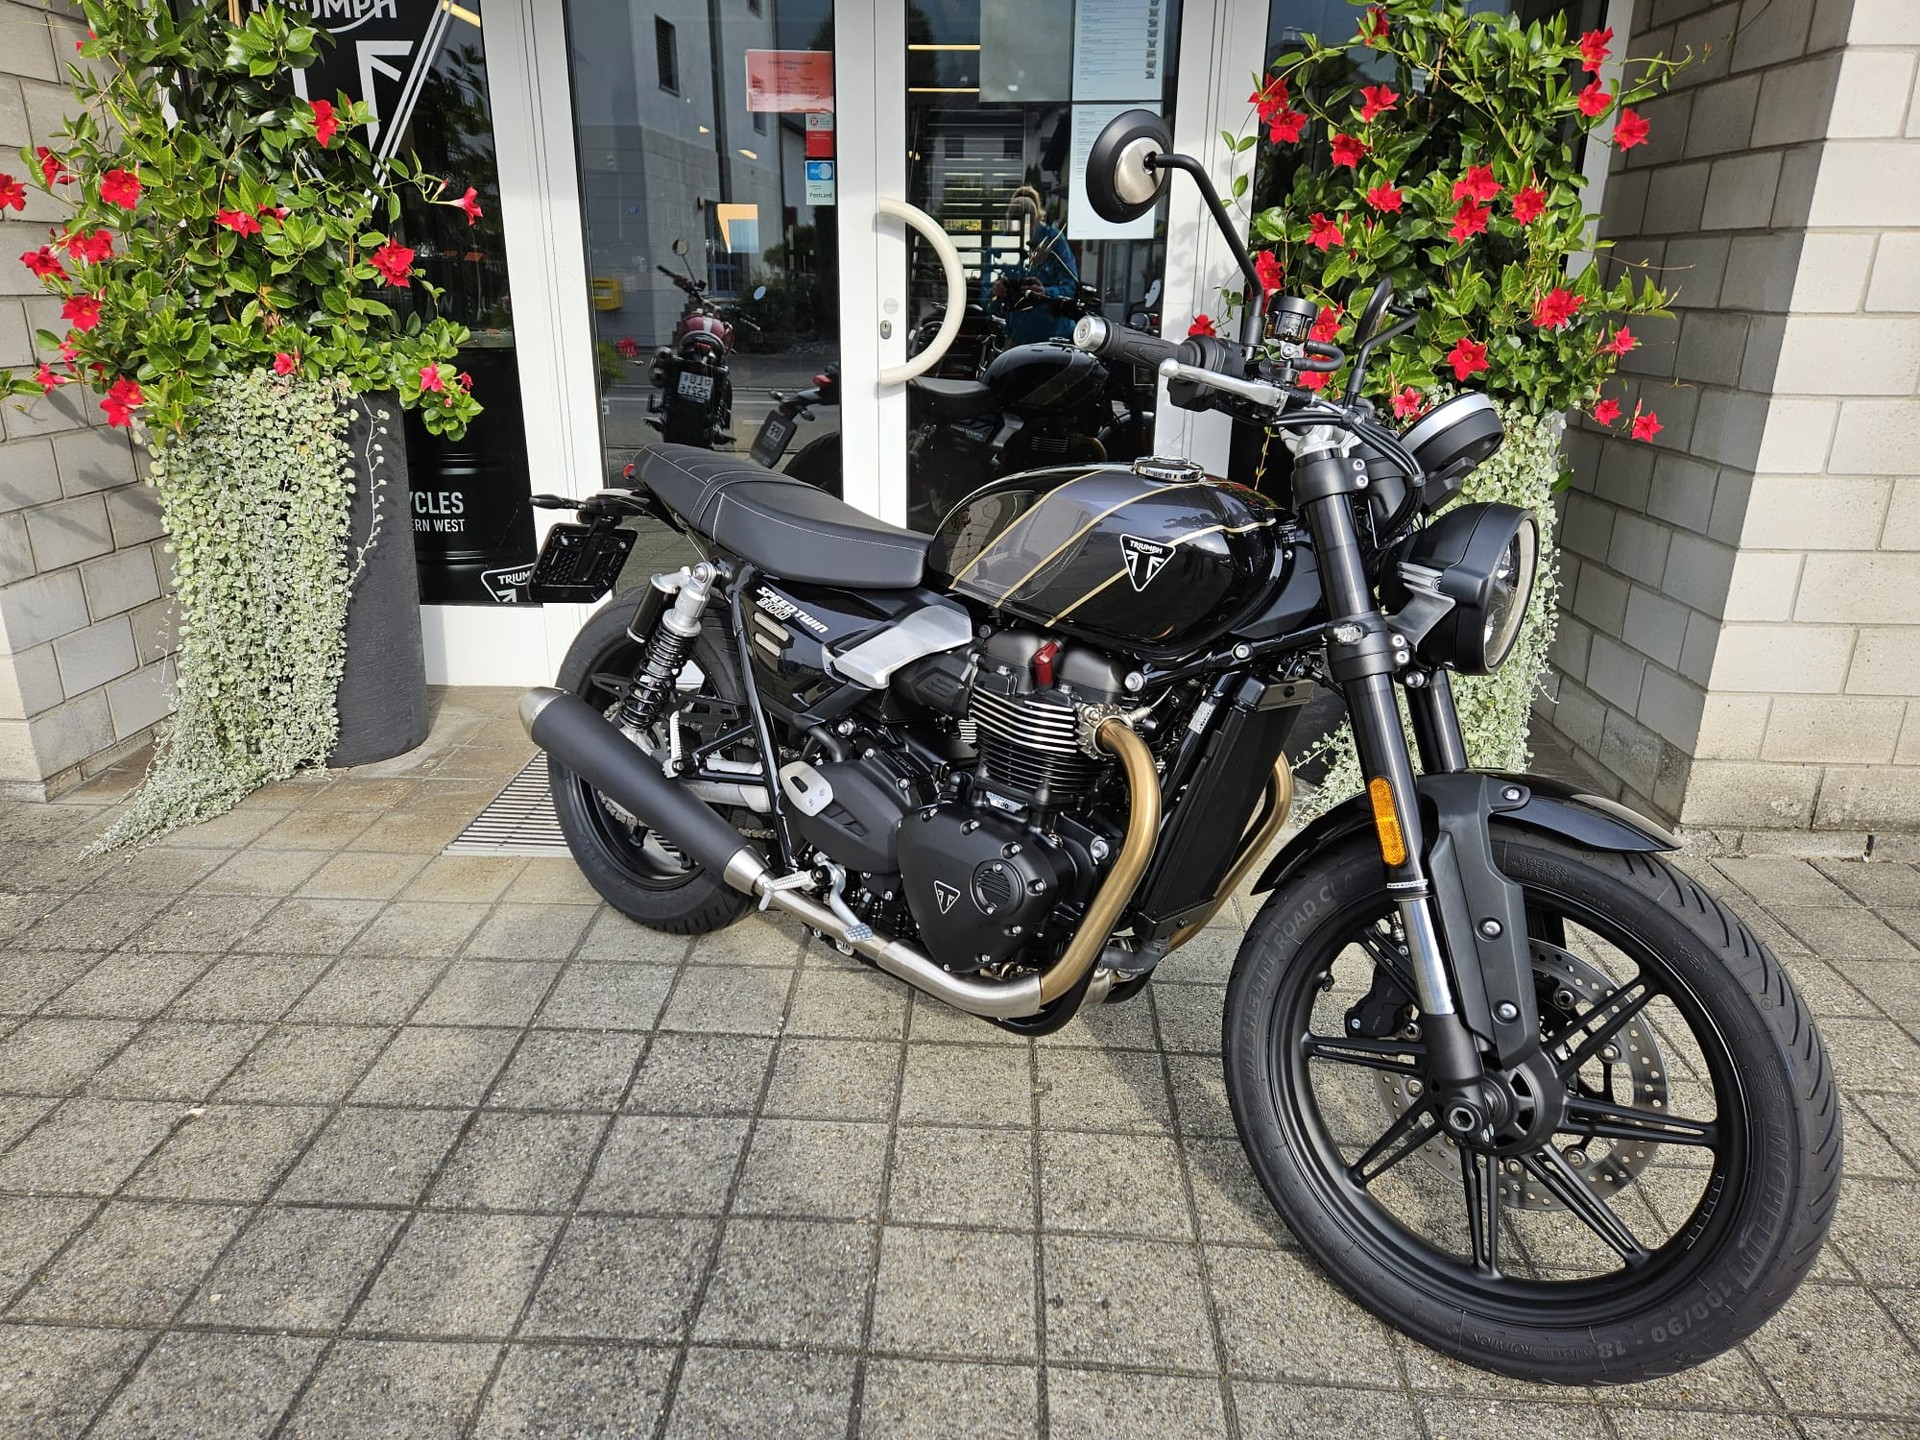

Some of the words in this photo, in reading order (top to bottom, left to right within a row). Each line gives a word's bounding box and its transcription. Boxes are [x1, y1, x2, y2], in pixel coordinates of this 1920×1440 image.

[409, 491, 465, 514] CLES
[411, 518, 431, 532] RN
[433, 518, 466, 532] WEST
[1130, 540, 1163, 554] TRIUMPH
[497, 570, 531, 585] TRIUM
[756, 597, 792, 620] 900
[756, 586, 798, 613] SPEED
[794, 610, 829, 634] TWIN
[1274, 899, 1317, 951] ROAD
[1741, 1121, 1789, 1277] MICHELIN
[1651, 1281, 1733, 1344] 100/90
